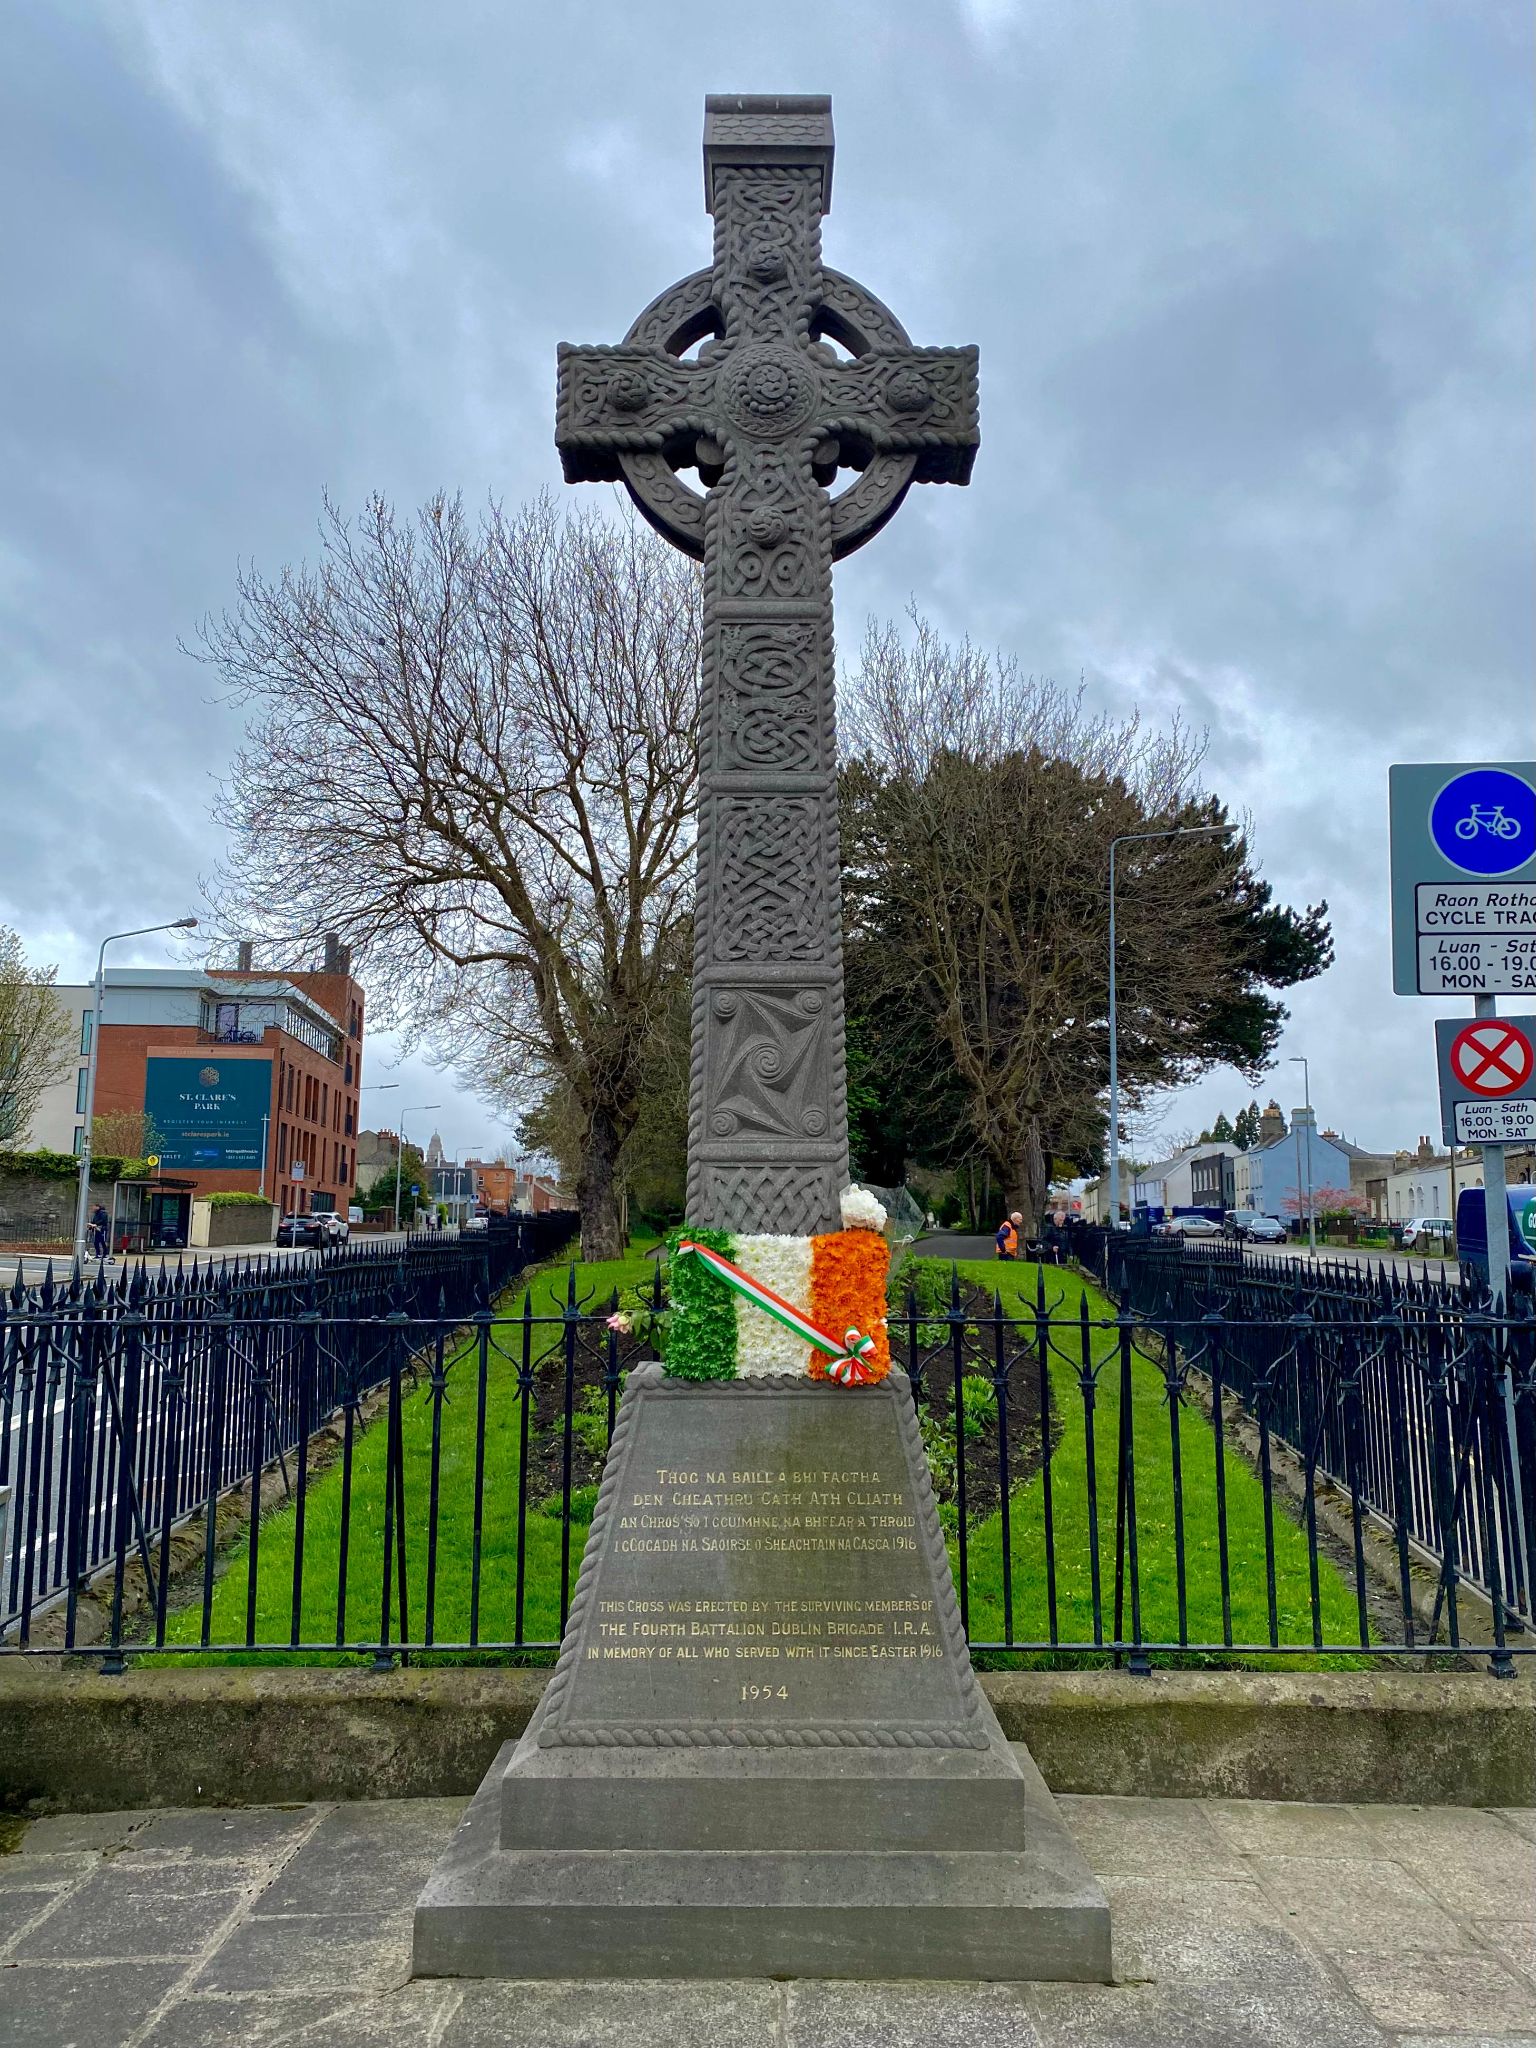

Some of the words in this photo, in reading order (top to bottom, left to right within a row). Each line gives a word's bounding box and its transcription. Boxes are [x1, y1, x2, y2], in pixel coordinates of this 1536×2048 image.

[1435, 893, 1479, 907] Raon
[1425, 911, 1486, 925] CYCLE
[1438, 940, 1480, 953] Luan
[1429, 956, 1480, 971] 16.00
[1442, 975, 1486, 988] MON
[1511, 974, 1536, 988] SA
[179, 1093, 193, 1101] ST.
[195, 1093, 236, 1101] CLARE'S
[1465, 1105, 1492, 1114] Luan
[1501, 1103, 1528, 1113] Sath
[1460, 1117, 1492, 1126] 16.00
[1502, 1115, 1534, 1125] 19.00
[1468, 1129, 1497, 1138] MON
[1506, 1127, 1528, 1137] SAT
[706, 1472, 727, 1484] NA
[732, 1472, 774, 1484] BAILL
[633, 1494, 663, 1506] DEN
[672, 1492, 753, 1506] CHEATHRU
[761, 1491, 802, 1505] CATH
[809, 1491, 841, 1505] ATH
[847, 1492, 903, 1505] CLIATH
[620, 1516, 637, 1528] AN
[641, 1514, 680, 1528] CHROS
[704, 1516, 708, 1528] I
[783, 1516, 801, 1528] NA
[858, 1516, 866, 1527] A
[870, 1516, 916, 1527] THROID
[614, 1540, 619, 1552] I
[681, 1540, 698, 1551] NA
[702, 1537, 752, 1551] SAOIRSE
[764, 1537, 836, 1551] SHEACHTAIN
[838, 1539, 852, 1550] NA
[892, 1536, 917, 1551] 1916
[600, 1601, 625, 1612] THIS
[627, 1600, 664, 1612] CROSS
[668, 1601, 691, 1612] WAS
[695, 1601, 748, 1612] ERECTED
[752, 1601, 769, 1612] BY
[775, 1601, 797, 1612] THE
[801, 1601, 862, 1612] SURVIVING
[865, 1600, 920, 1612] MEMBERS
[921, 1600, 933, 1611] OF
[600, 1623, 627, 1636] THE
[632, 1622, 686, 1636] FOURTH
[691, 1622, 765, 1636] BATTALION
[771, 1622, 821, 1635] DUBLIN
[827, 1622, 884, 1635] BRIGADE
[588, 1647, 599, 1659] IN
[603, 1647, 655, 1659] MEMORY
[659, 1647, 672, 1658] OF
[676, 1647, 699, 1658] ALL
[703, 1647, 730, 1658] WHO
[735, 1646, 780, 1658] SERVED
[785, 1646, 814, 1658] WITH
[819, 1647, 829, 1658] IT
[834, 1646, 868, 1658] SINCE
[871, 1645, 918, 1658] EASTER
[920, 1643, 944, 1659] 1916
[741, 1685, 789, 1700] 1954
